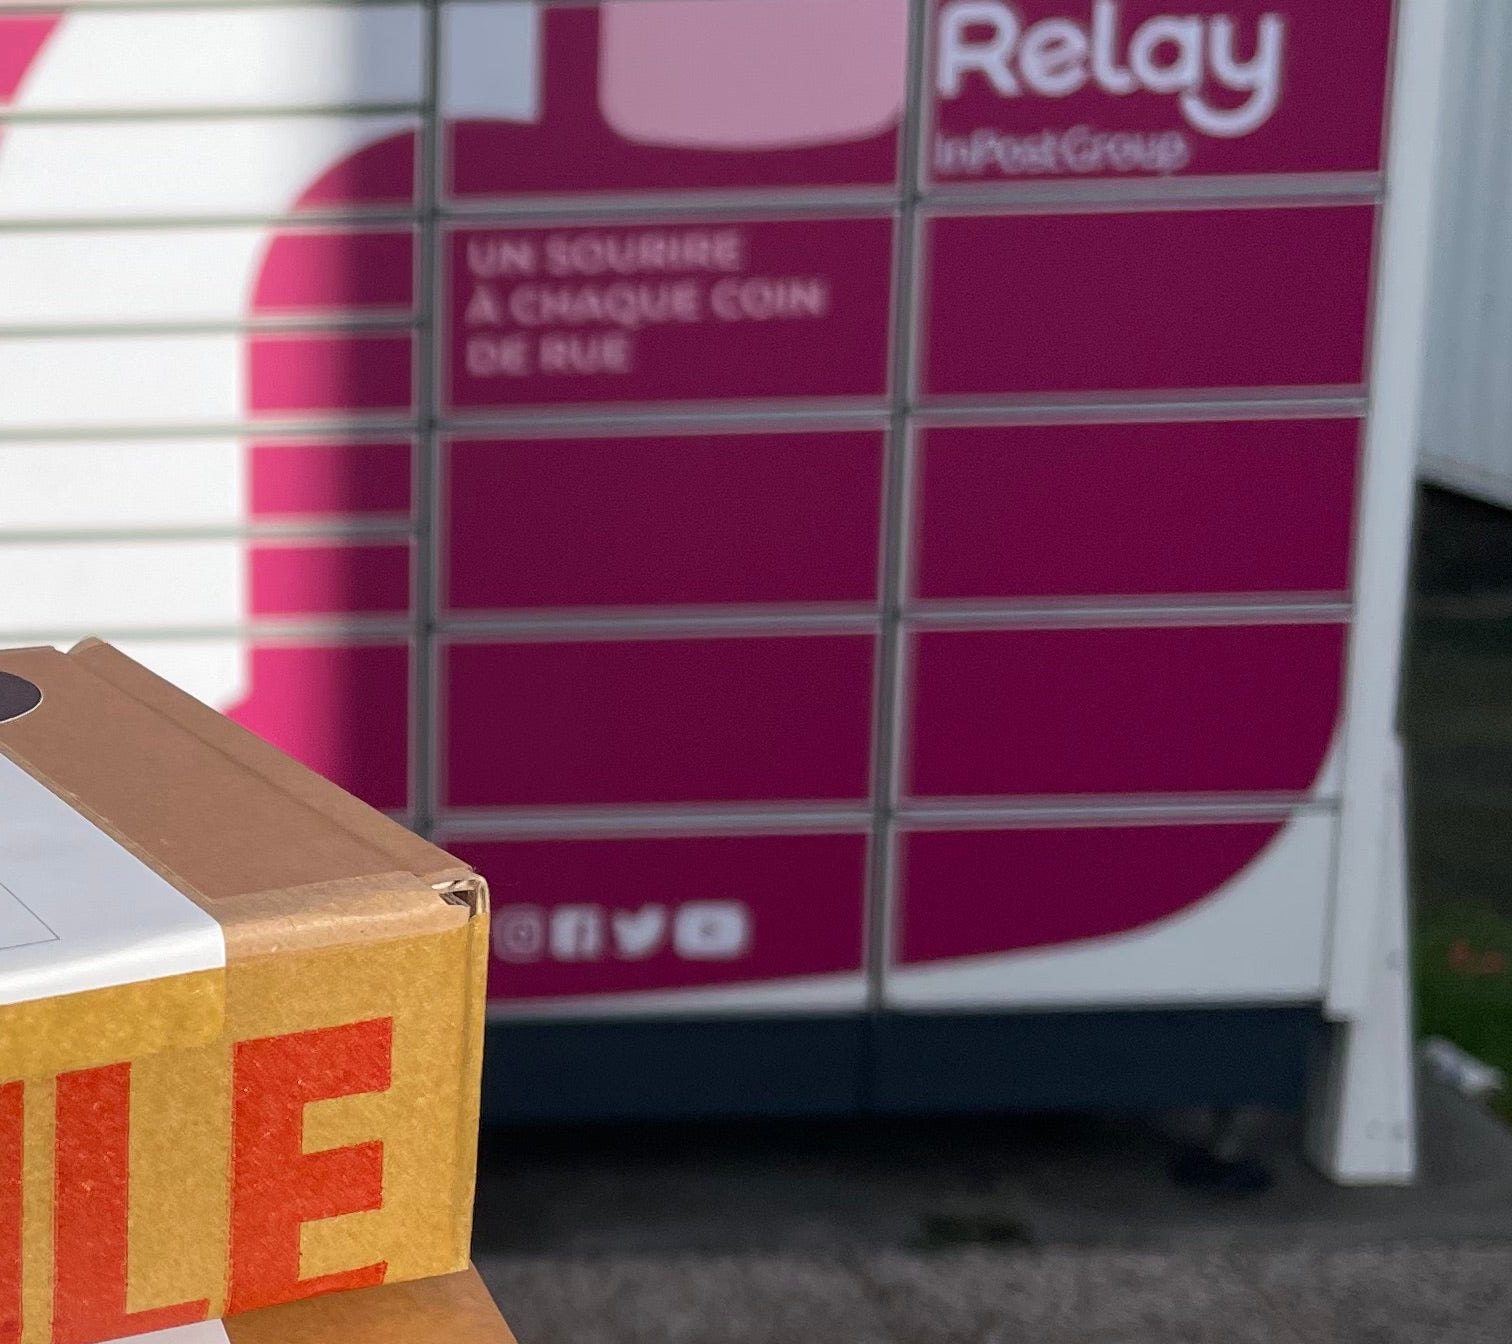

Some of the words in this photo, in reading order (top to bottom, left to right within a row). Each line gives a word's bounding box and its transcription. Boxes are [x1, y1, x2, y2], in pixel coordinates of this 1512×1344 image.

[466, 235, 537, 277] UN
[544, 228, 745, 277] SOURIRE
[508, 278, 700, 331] CHAQUE
[709, 274, 829, 322] COIN
[465, 333, 530, 377] DE
[538, 331, 634, 375] RUE
